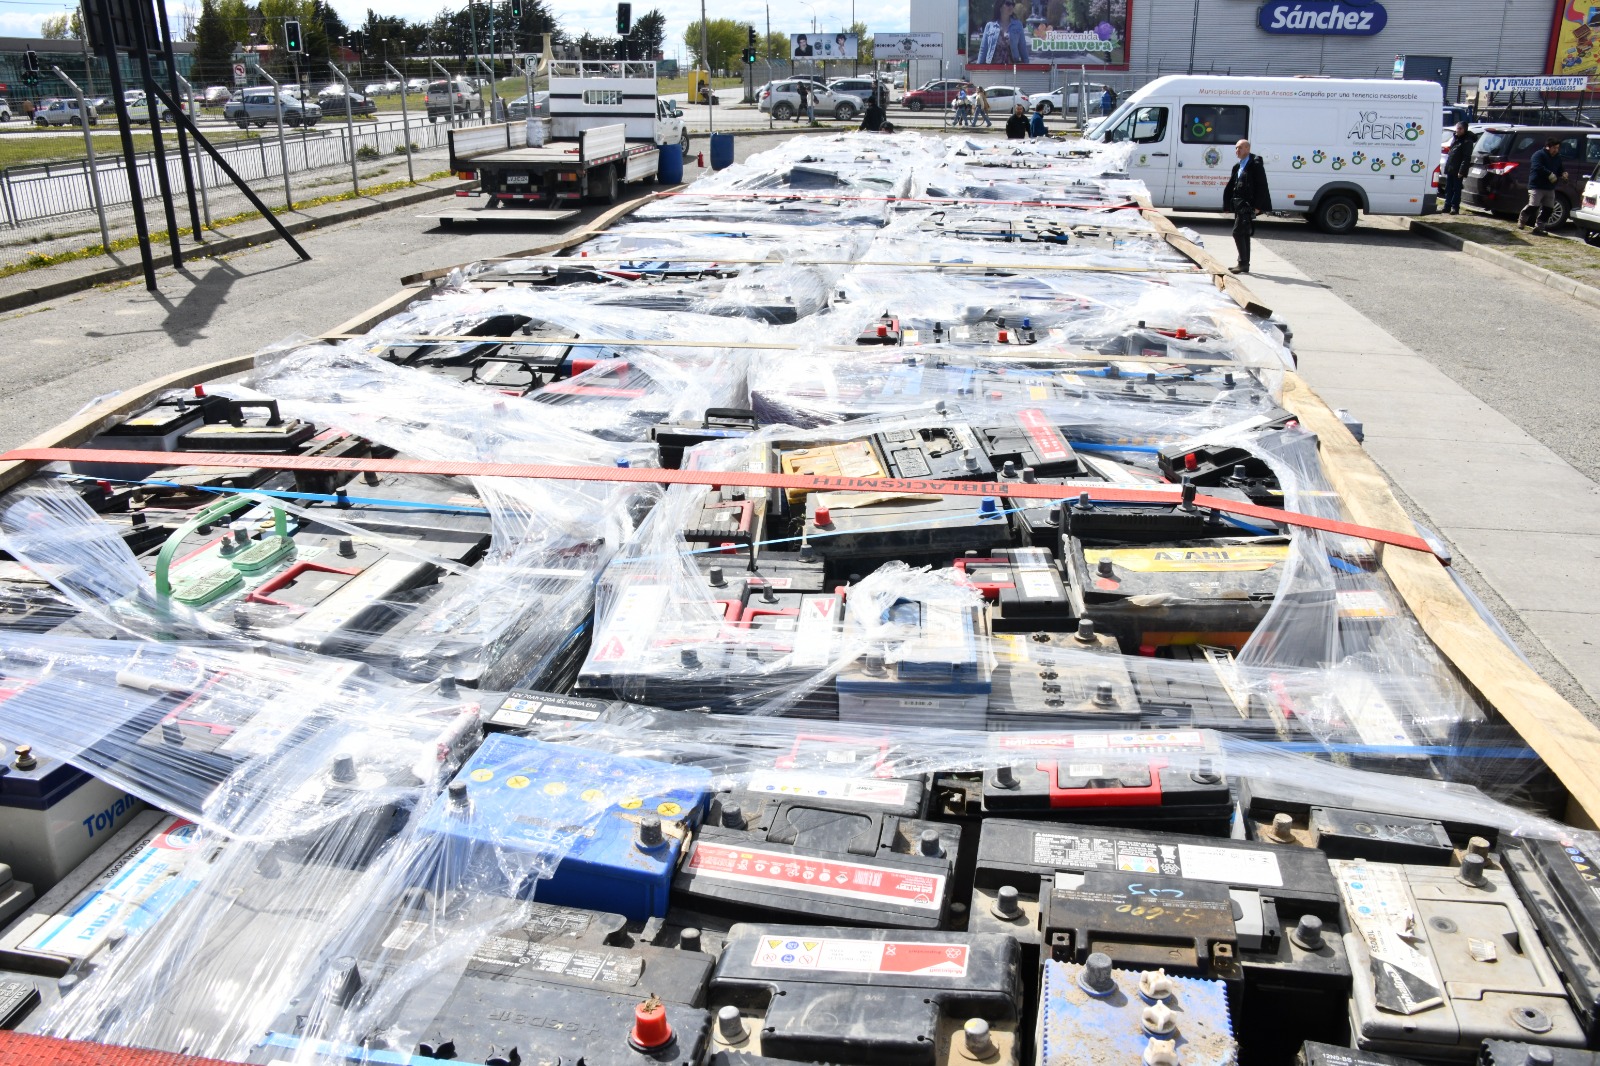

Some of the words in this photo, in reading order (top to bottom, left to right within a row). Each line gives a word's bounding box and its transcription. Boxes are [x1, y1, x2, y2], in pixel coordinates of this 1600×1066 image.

[1271, 5, 1374, 30] Sánchez
[1047, 31, 1099, 41] Bienvenida
[1031, 38, 1112, 51] Primavera
[1485, 79, 1507, 91] JYJ
[1508, 78, 1535, 87] VENTANAS
[1535, 78, 1542, 86] DE
[1543, 78, 1566, 86] ALUMINIO
[1567, 78, 1573, 86] Y
[1573, 78, 1584, 86] PVC
[1199, 88, 1241, 97] Municipalidad
[1298, 91, 1325, 99] Campaña
[1380, 93, 1418, 101] responsable
[1359, 111, 1378, 123] YO
[198, 455, 342, 470] BLACKSMITH
[812, 477, 979, 493] BLACKSMITH
[896, 884, 920, 892] BATTERY
